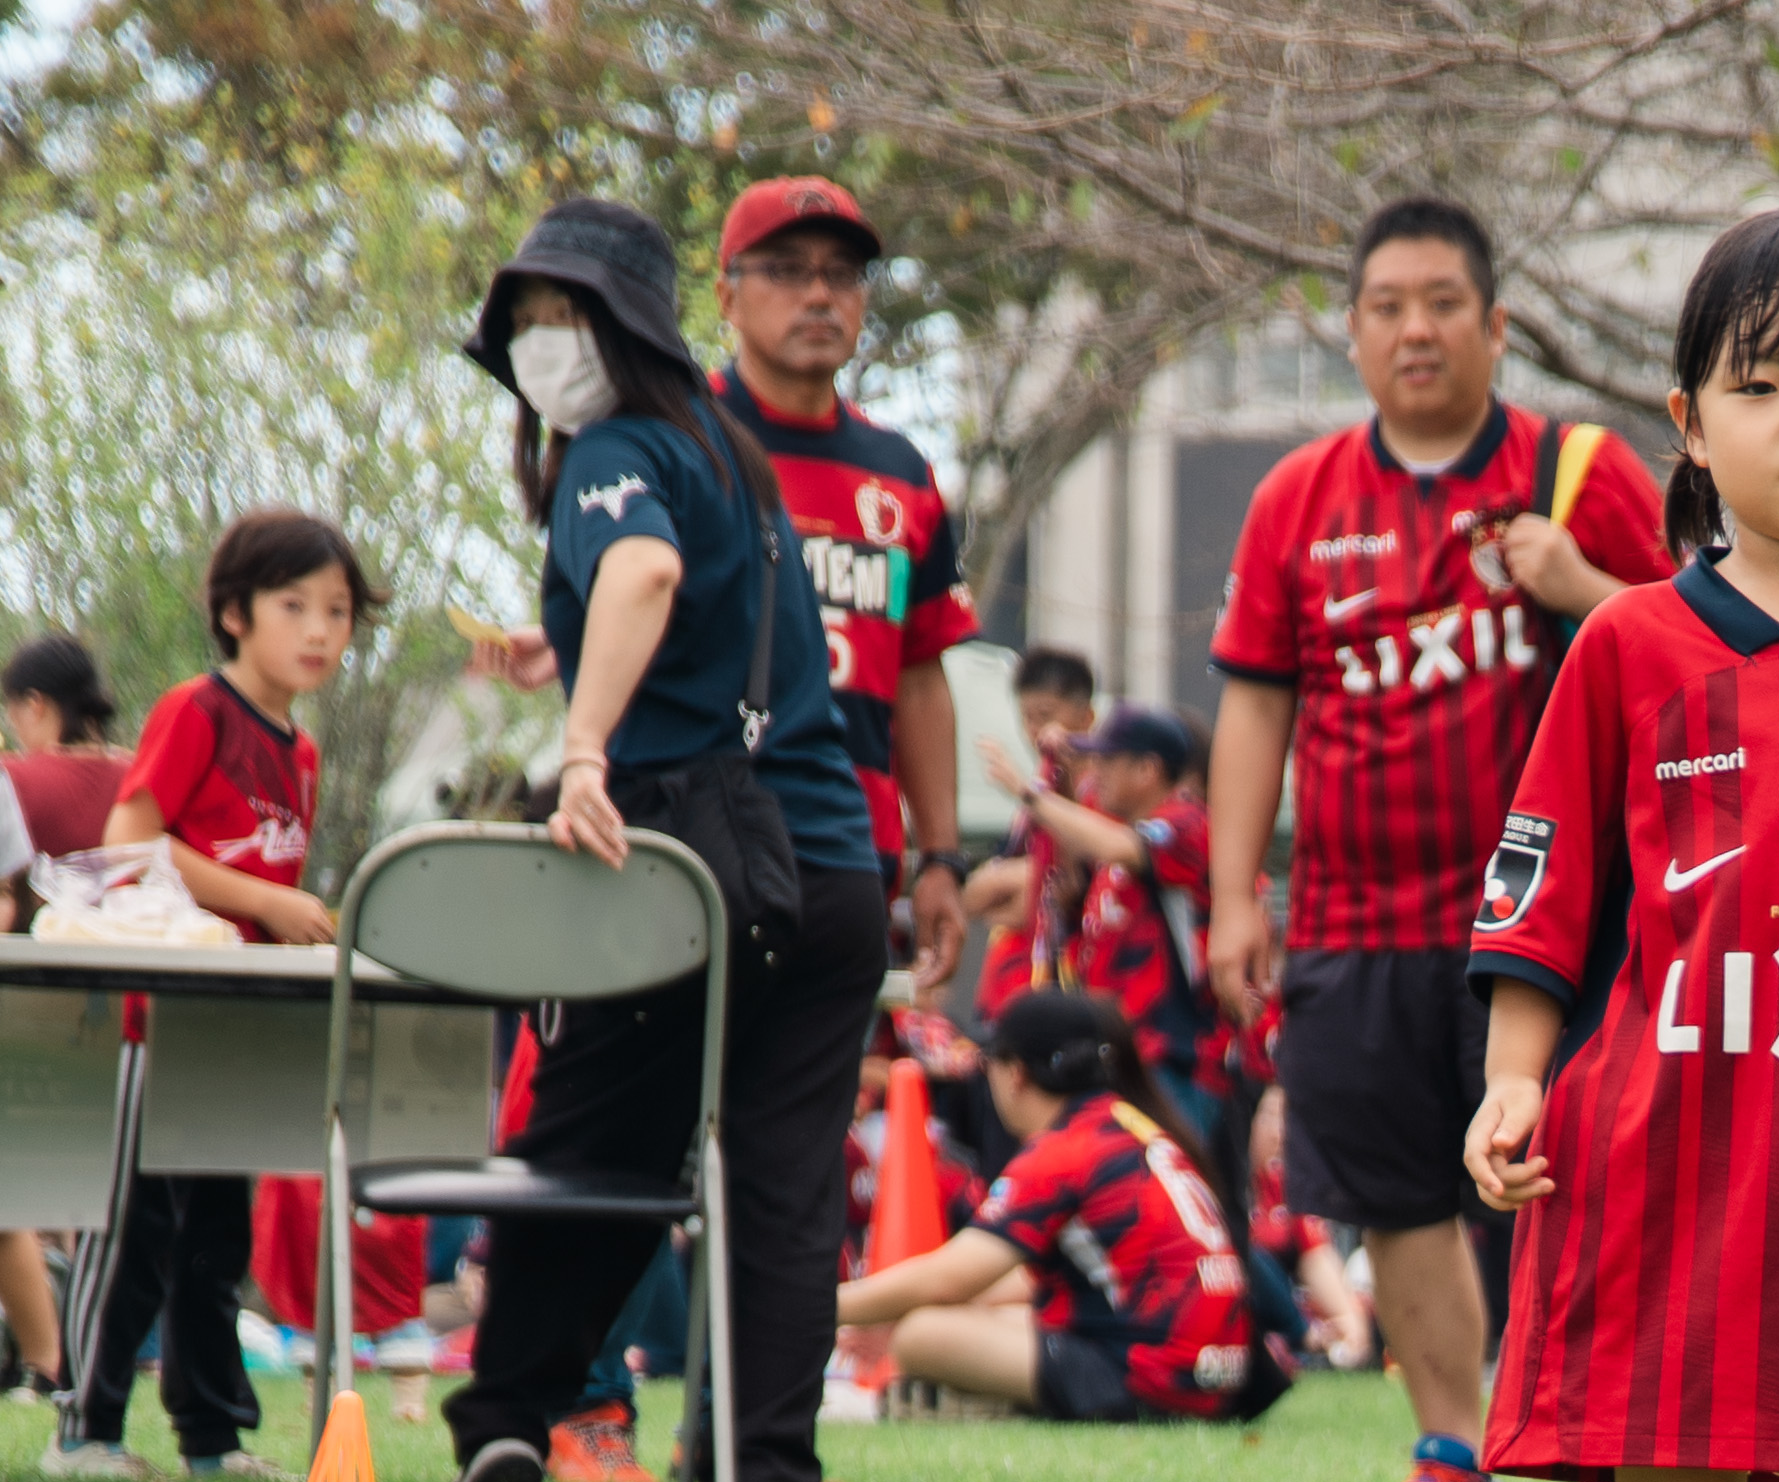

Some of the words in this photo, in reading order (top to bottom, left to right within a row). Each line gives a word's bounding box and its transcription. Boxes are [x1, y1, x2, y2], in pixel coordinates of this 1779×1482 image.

[802, 536, 888, 612] TEM
[1334, 604, 1538, 694] LIXIL
[1655, 747, 1746, 780] mercari
